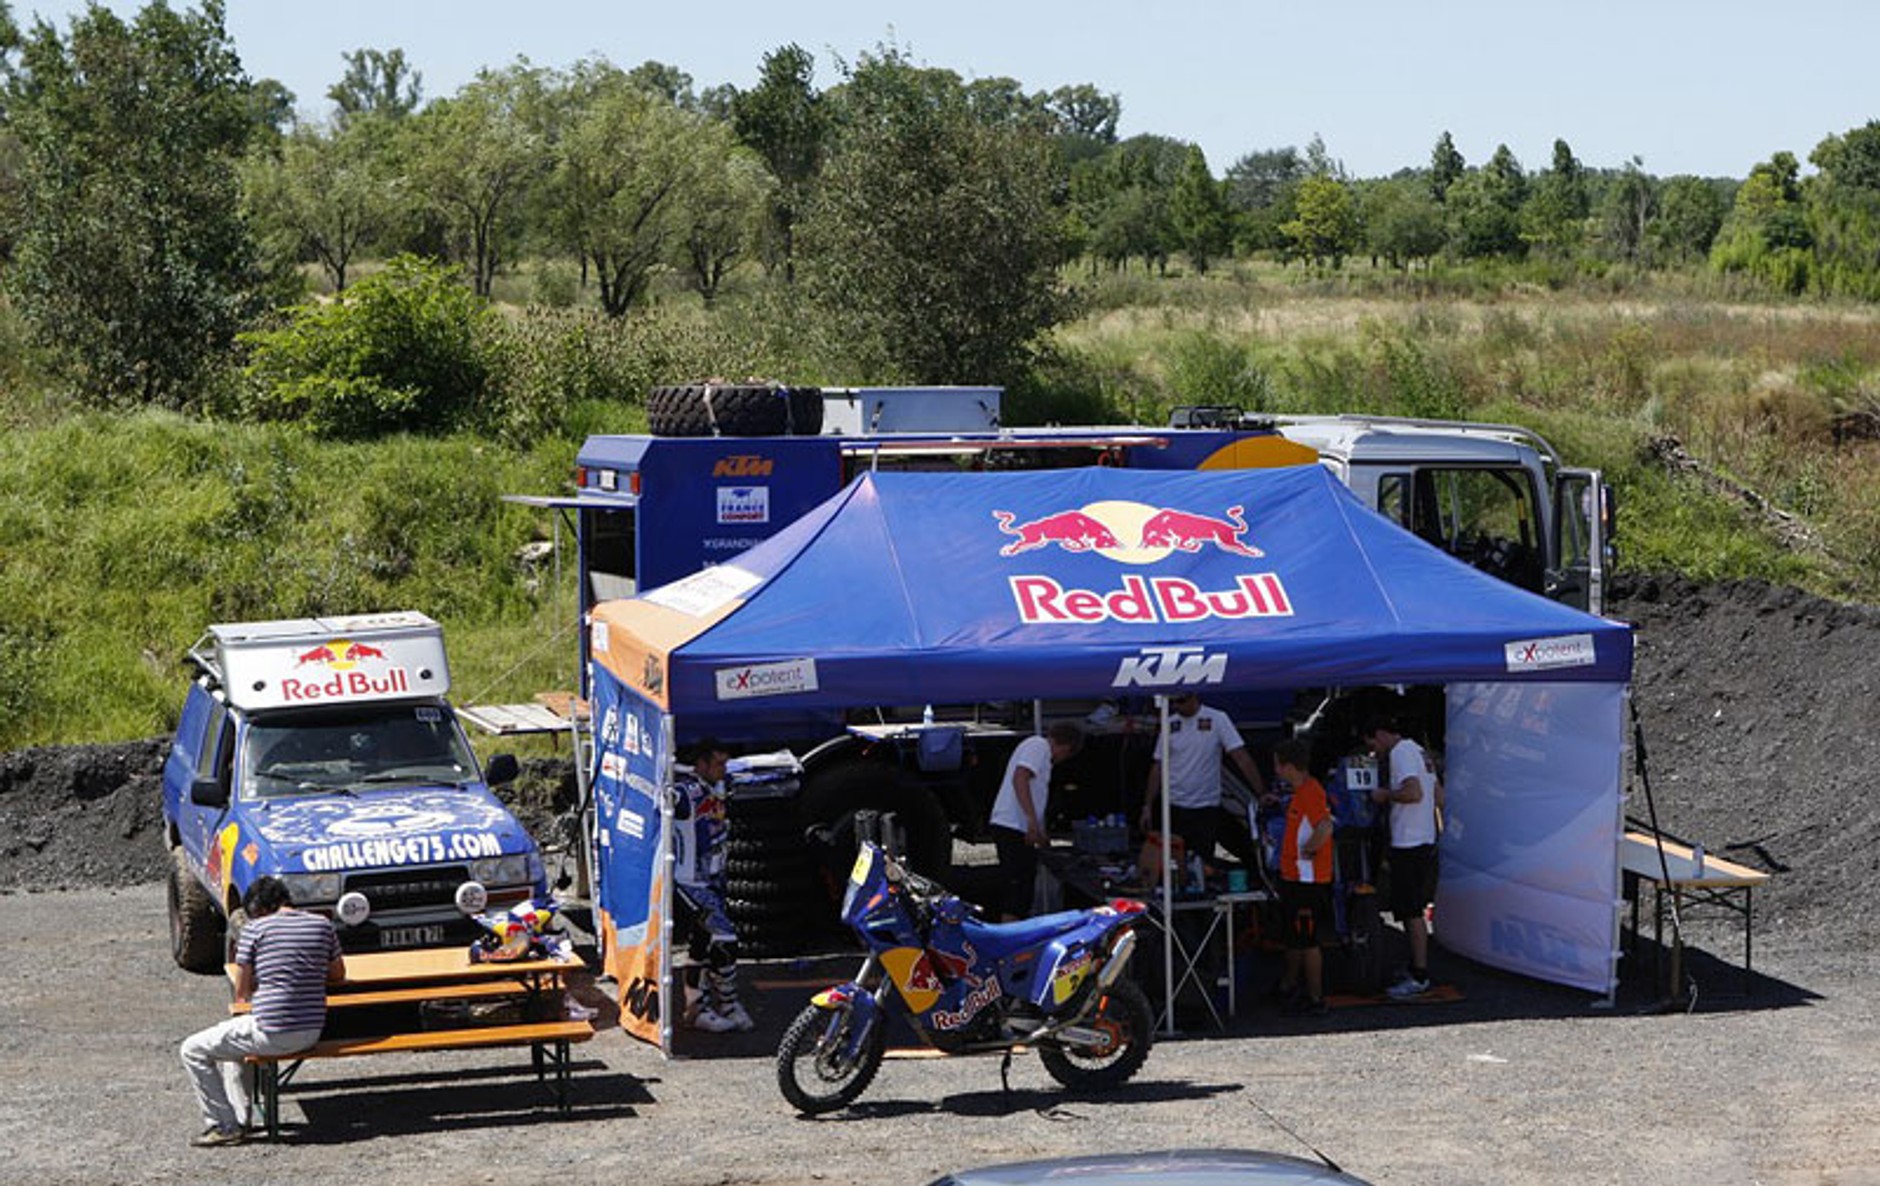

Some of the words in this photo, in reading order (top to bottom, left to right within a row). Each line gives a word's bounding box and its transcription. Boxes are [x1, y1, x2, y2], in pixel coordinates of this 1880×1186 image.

[712, 455, 774, 477] KTM
[1011, 576, 1156, 622] Red
[1152, 574, 1292, 621] Bull
[1112, 646, 1228, 687] KTM
[281, 672, 344, 701] Red
[348, 668, 408, 695] Bull
[1355, 769, 1372, 786] 19
[302, 833, 502, 870] CHALLENGE75.COM
[375, 881, 443, 896] TOYOTA
[932, 998, 974, 1030] Red
[966, 975, 1002, 1011] Bull
